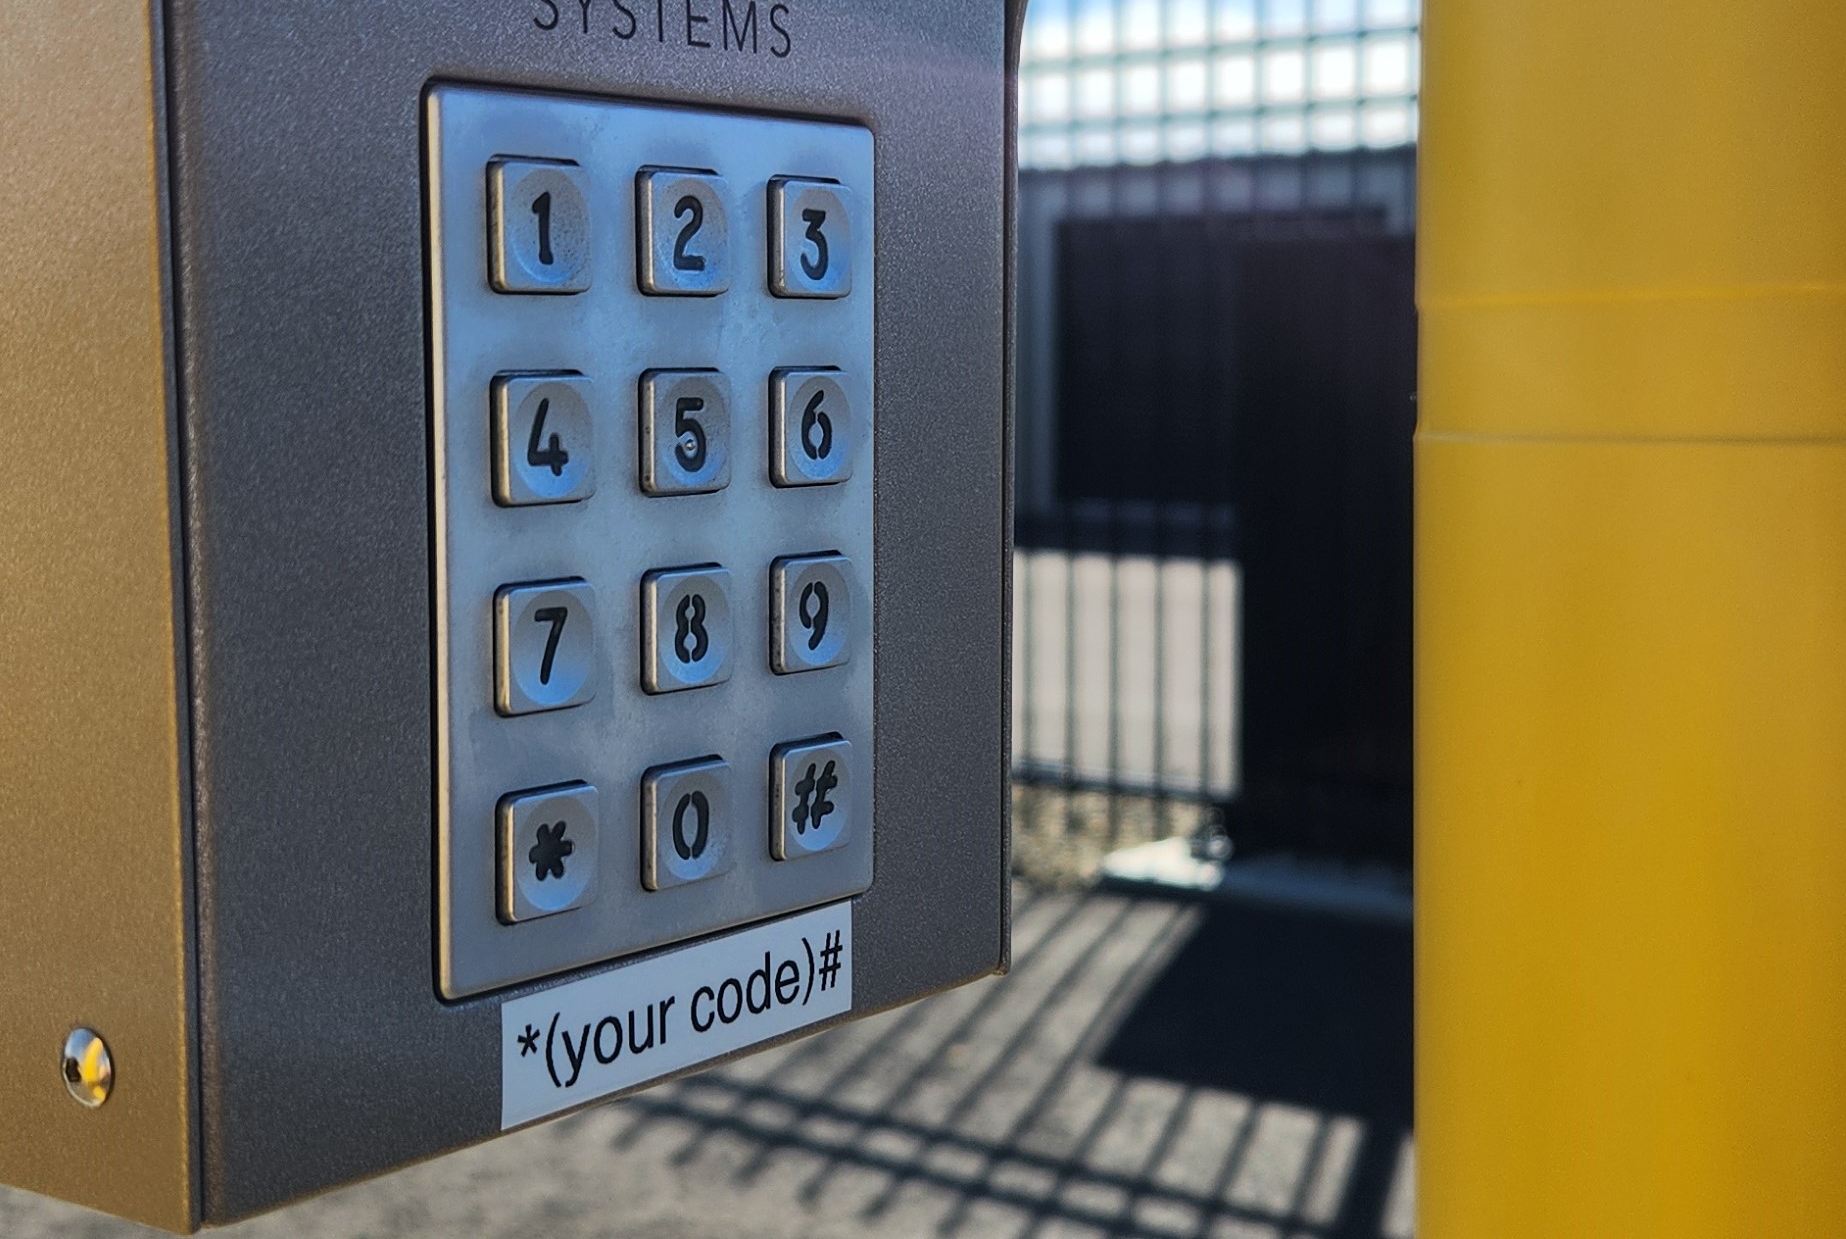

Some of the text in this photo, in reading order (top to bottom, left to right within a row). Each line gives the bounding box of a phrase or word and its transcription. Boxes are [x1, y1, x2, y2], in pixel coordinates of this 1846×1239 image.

[531, 191, 554, 265] 1
[673, 195, 706, 271] 2
[800, 208, 828, 280] 3
[527, 397, 569, 477] 4
[674, 397, 706, 473] 5
[801, 389, 832, 460] 6
[534, 606, 568, 685] 7
[674, 593, 709, 664] 8
[799, 580, 829, 650] 9
[672, 790, 709, 860] 0
[792, 759, 838, 835] #
[690, 929, 843, 1033] code)#
